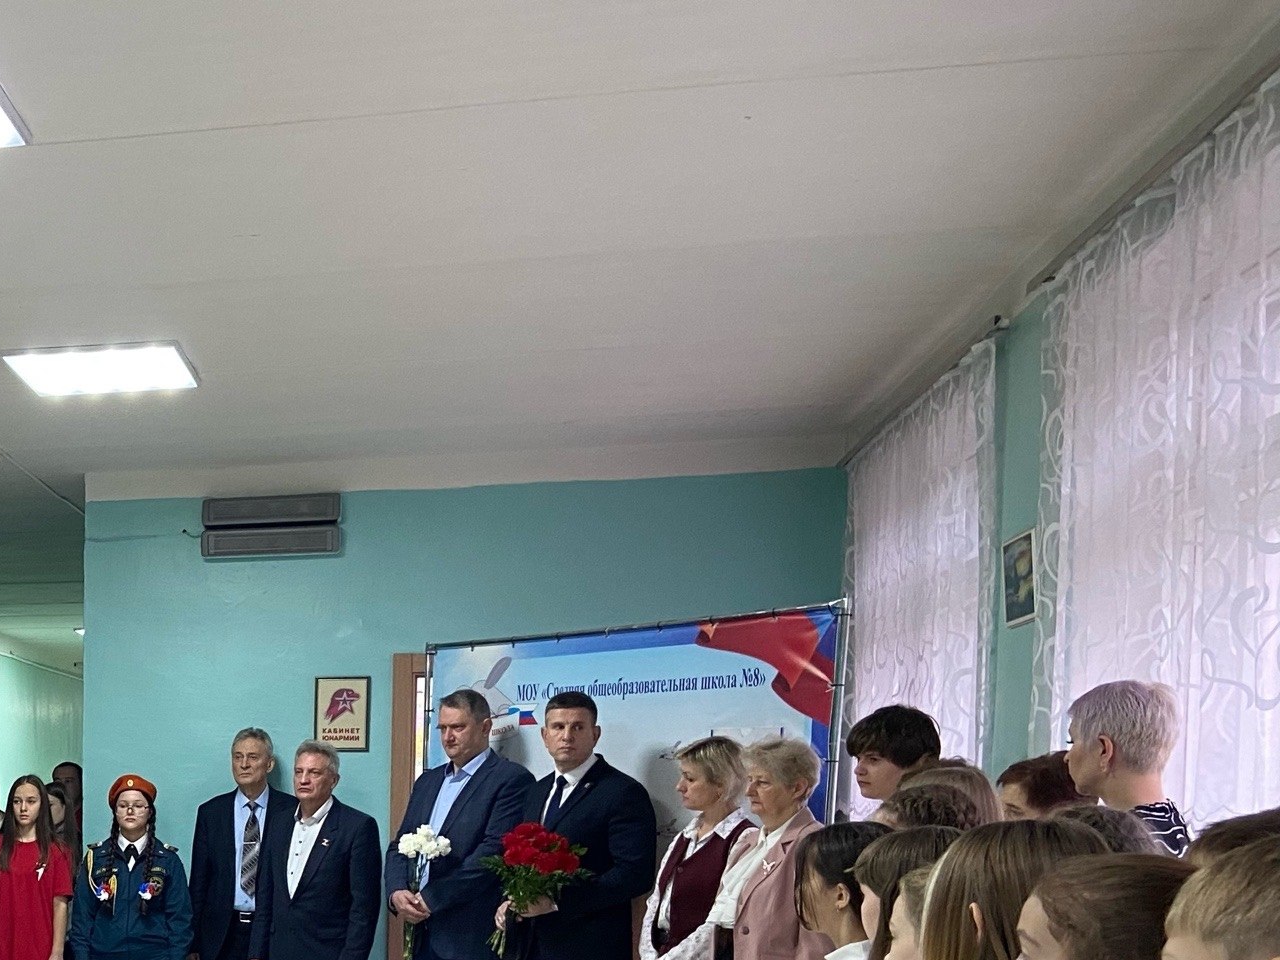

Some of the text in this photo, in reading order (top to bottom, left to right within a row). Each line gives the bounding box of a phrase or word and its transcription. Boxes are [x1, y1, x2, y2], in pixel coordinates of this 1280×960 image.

[517, 683, 540, 701] МОУ
[587, 676, 698, 701] общеобразовательная
[701, 673, 737, 690] школа
[739, 667, 766, 688] №8»
